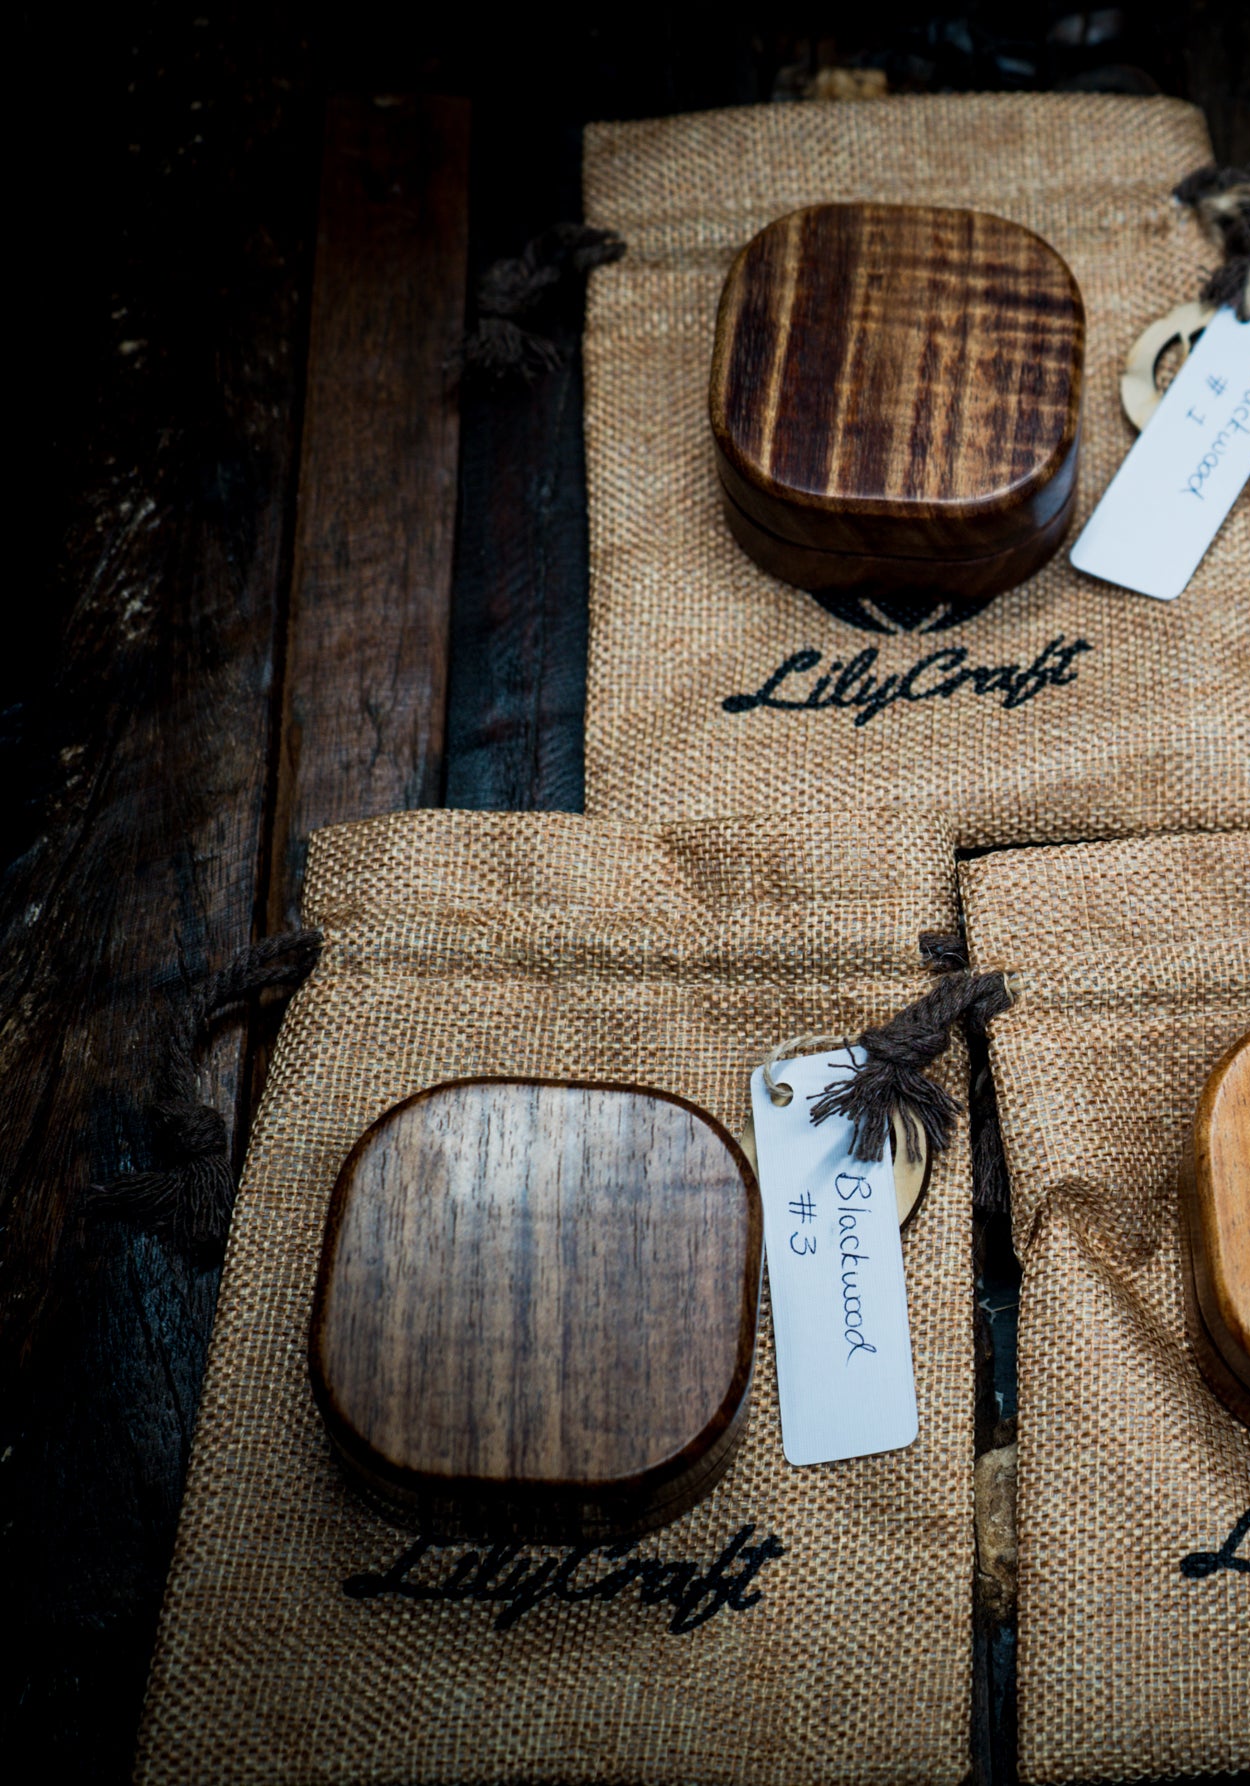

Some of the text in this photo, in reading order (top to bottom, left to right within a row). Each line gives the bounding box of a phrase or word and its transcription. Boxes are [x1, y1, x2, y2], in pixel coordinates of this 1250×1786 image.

[722, 634, 1093, 727] LilyCraft
[834, 1171, 877, 1367] Blackwood
[342, 1523, 785, 1635] LilyCraft
